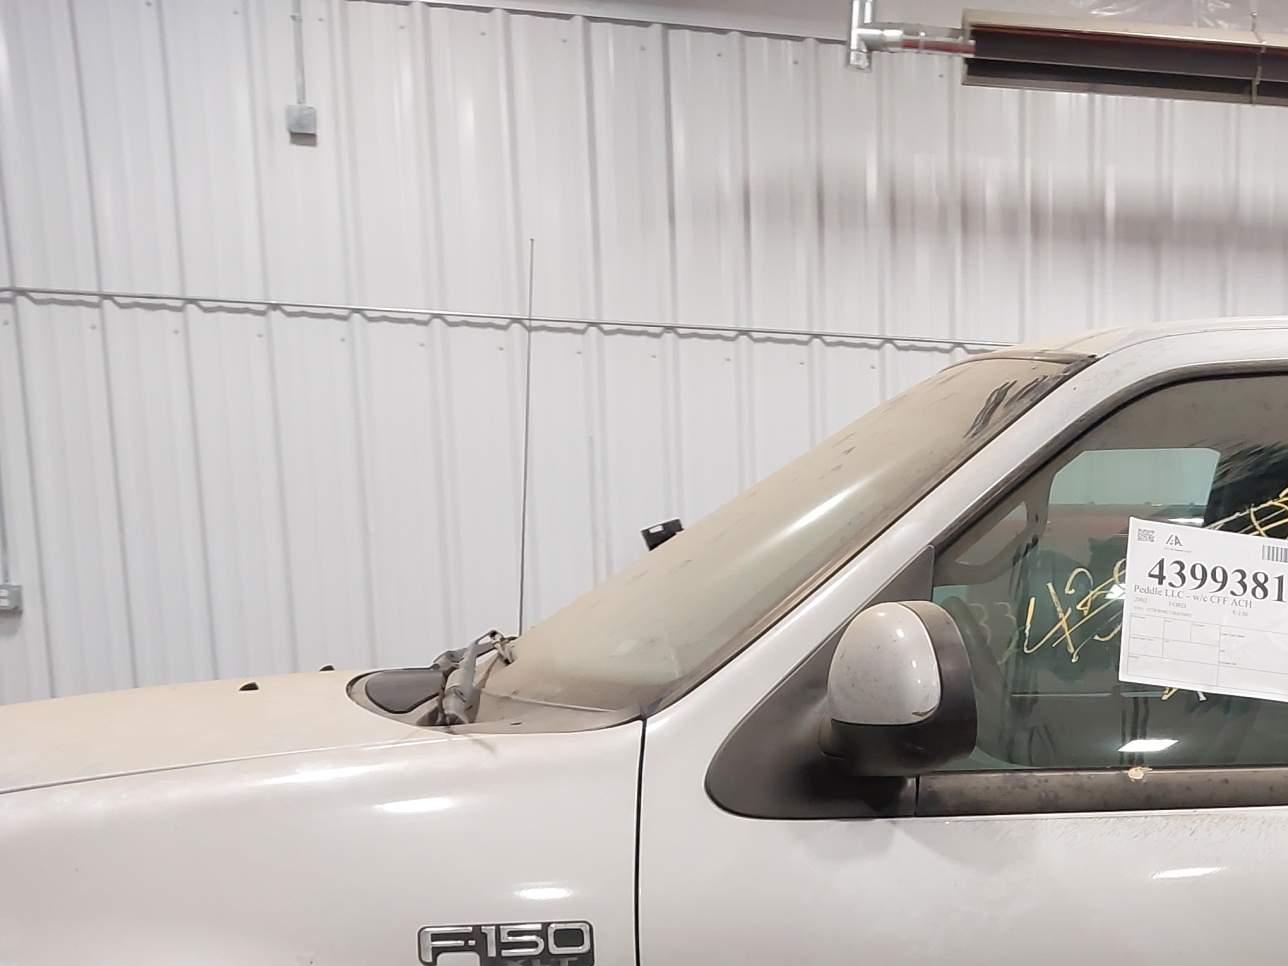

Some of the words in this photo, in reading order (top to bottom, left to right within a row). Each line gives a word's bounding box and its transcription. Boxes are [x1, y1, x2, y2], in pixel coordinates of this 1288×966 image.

[1133, 584, 1162, 597] Peddle
[1164, 589, 1185, 600] LLC
[419, 922, 592, 963] F-150
